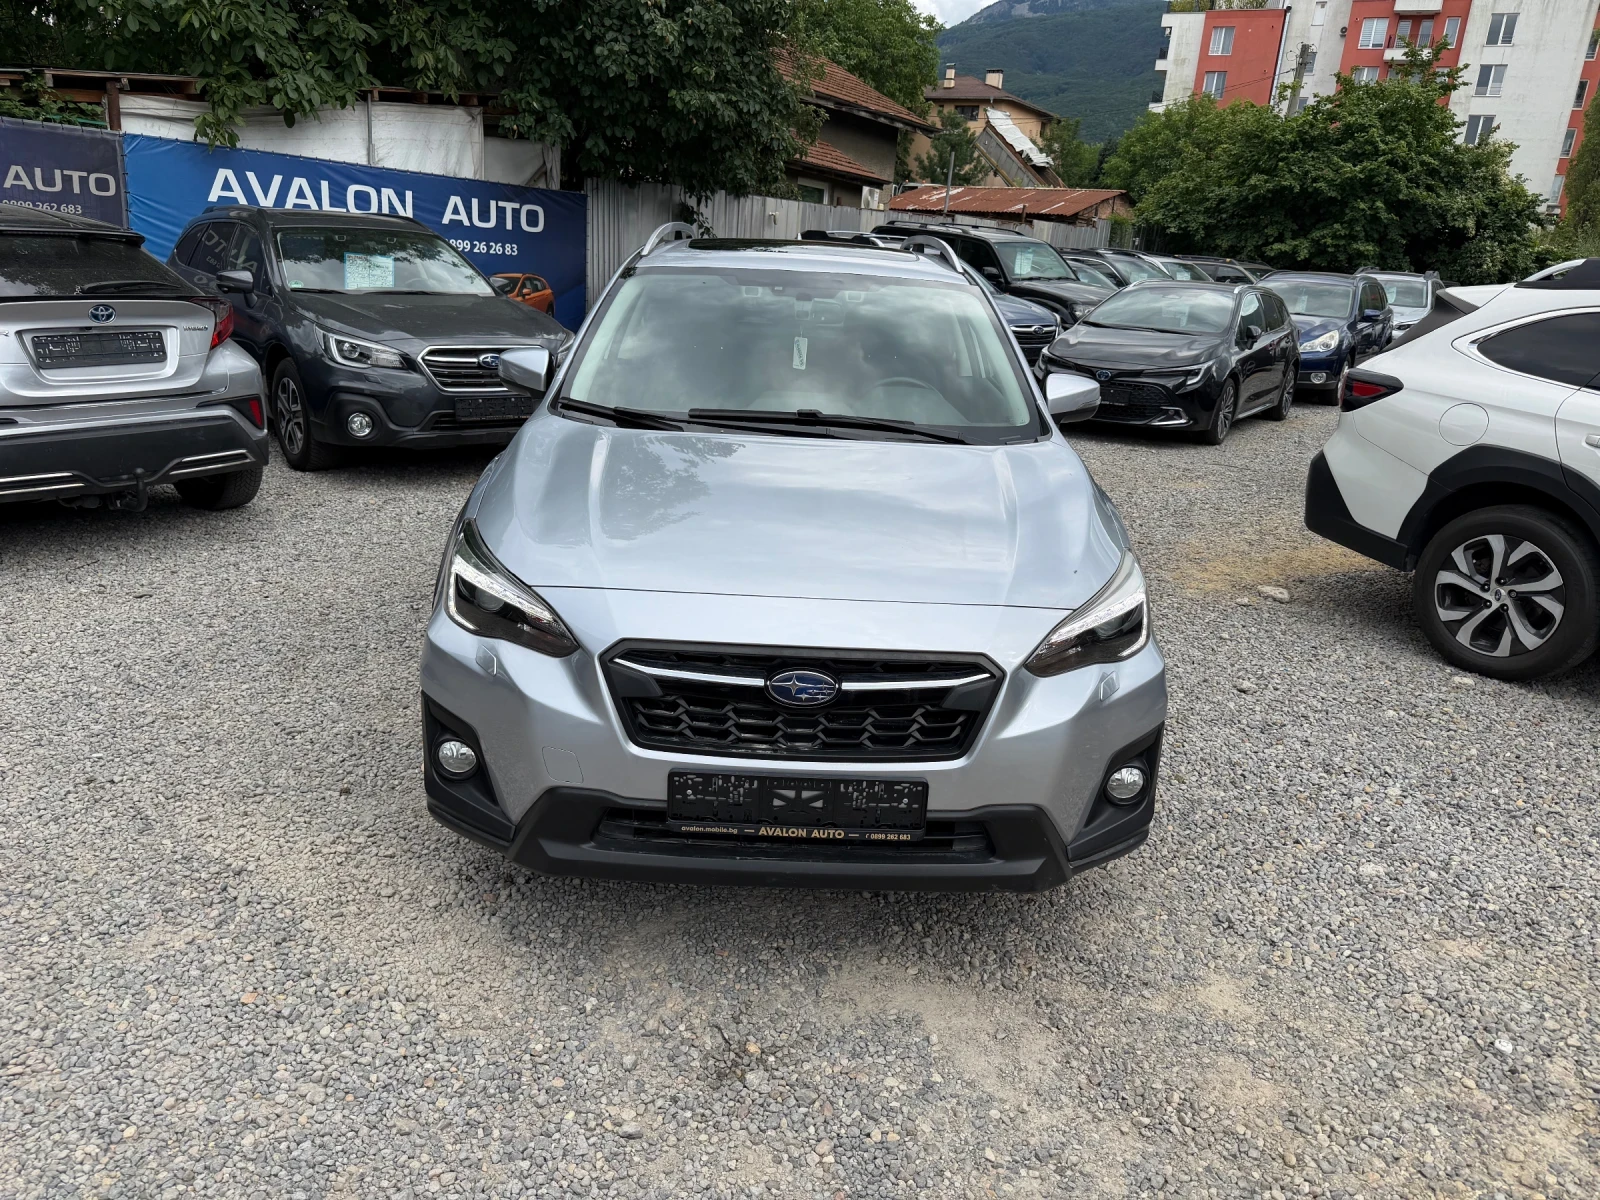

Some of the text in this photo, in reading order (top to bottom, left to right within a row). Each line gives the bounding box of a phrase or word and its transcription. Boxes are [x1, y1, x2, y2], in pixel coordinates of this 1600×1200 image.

[3, 165, 116, 197] AUTO
[60, 204, 82, 214] 683
[207, 168, 545, 233] AVALON AUTO
[446, 239, 518, 256] 899 26 26 83
[681, 825, 738, 834] avalon.mobile.bg
[759, 826, 807, 837] AVALON
[811, 829, 845, 839] AUTO
